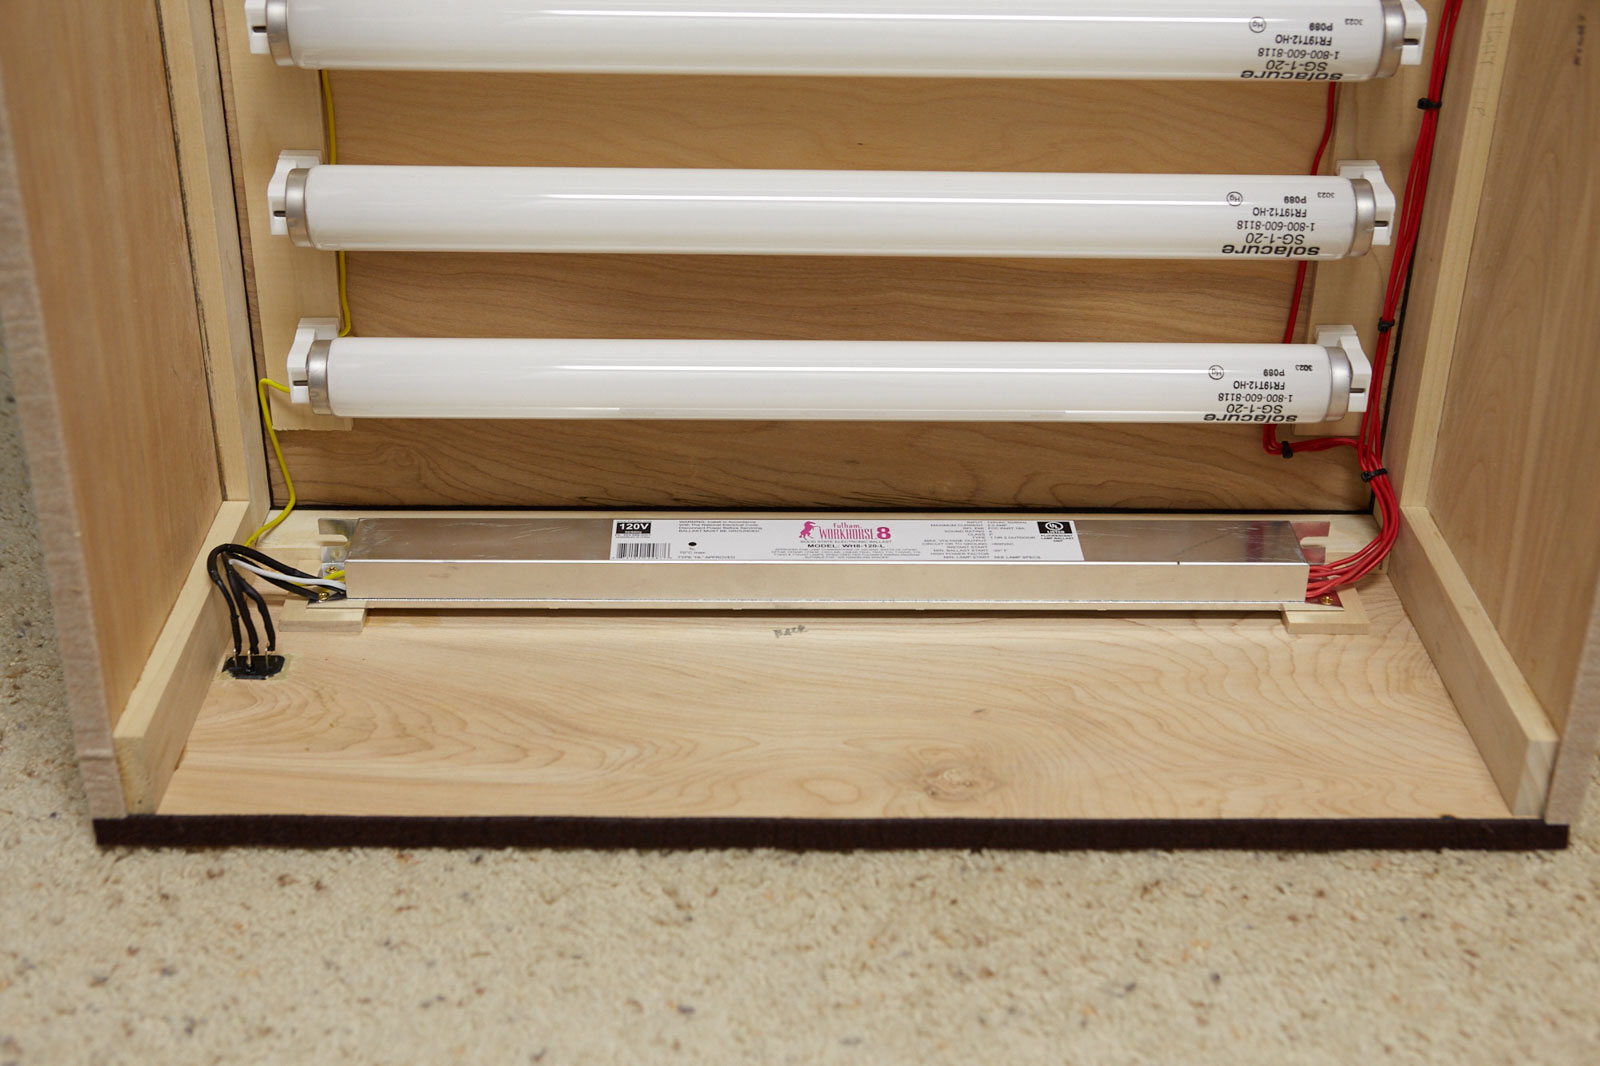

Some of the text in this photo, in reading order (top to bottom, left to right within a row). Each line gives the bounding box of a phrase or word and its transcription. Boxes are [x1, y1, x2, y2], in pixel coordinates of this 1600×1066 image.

[1309, 23, 1333, 31] P089
[1275, 34, 1332, 46] FR19T12-HO
[1257, 48, 1340, 59] 1-800-600-8118
[1266, 60, 1328, 71] SG-1-20
[1240, 70, 1343, 81] solacure
[1253, 207, 1307, 217] FR19T12-HO
[1237, 221, 1315, 231] 1-800-600-8118
[1246, 233, 1305, 245] SG-1-20
[1222, 245, 1320, 257] solacure
[1233, 381, 1285, 390] FR19T12-HO
[1218, 393, 1293, 402] 1-800-600-8118
[1226, 404, 1283, 414] SG-1-20
[1203, 414, 1297, 423] solacure
[877, 527, 891, 540] 8
